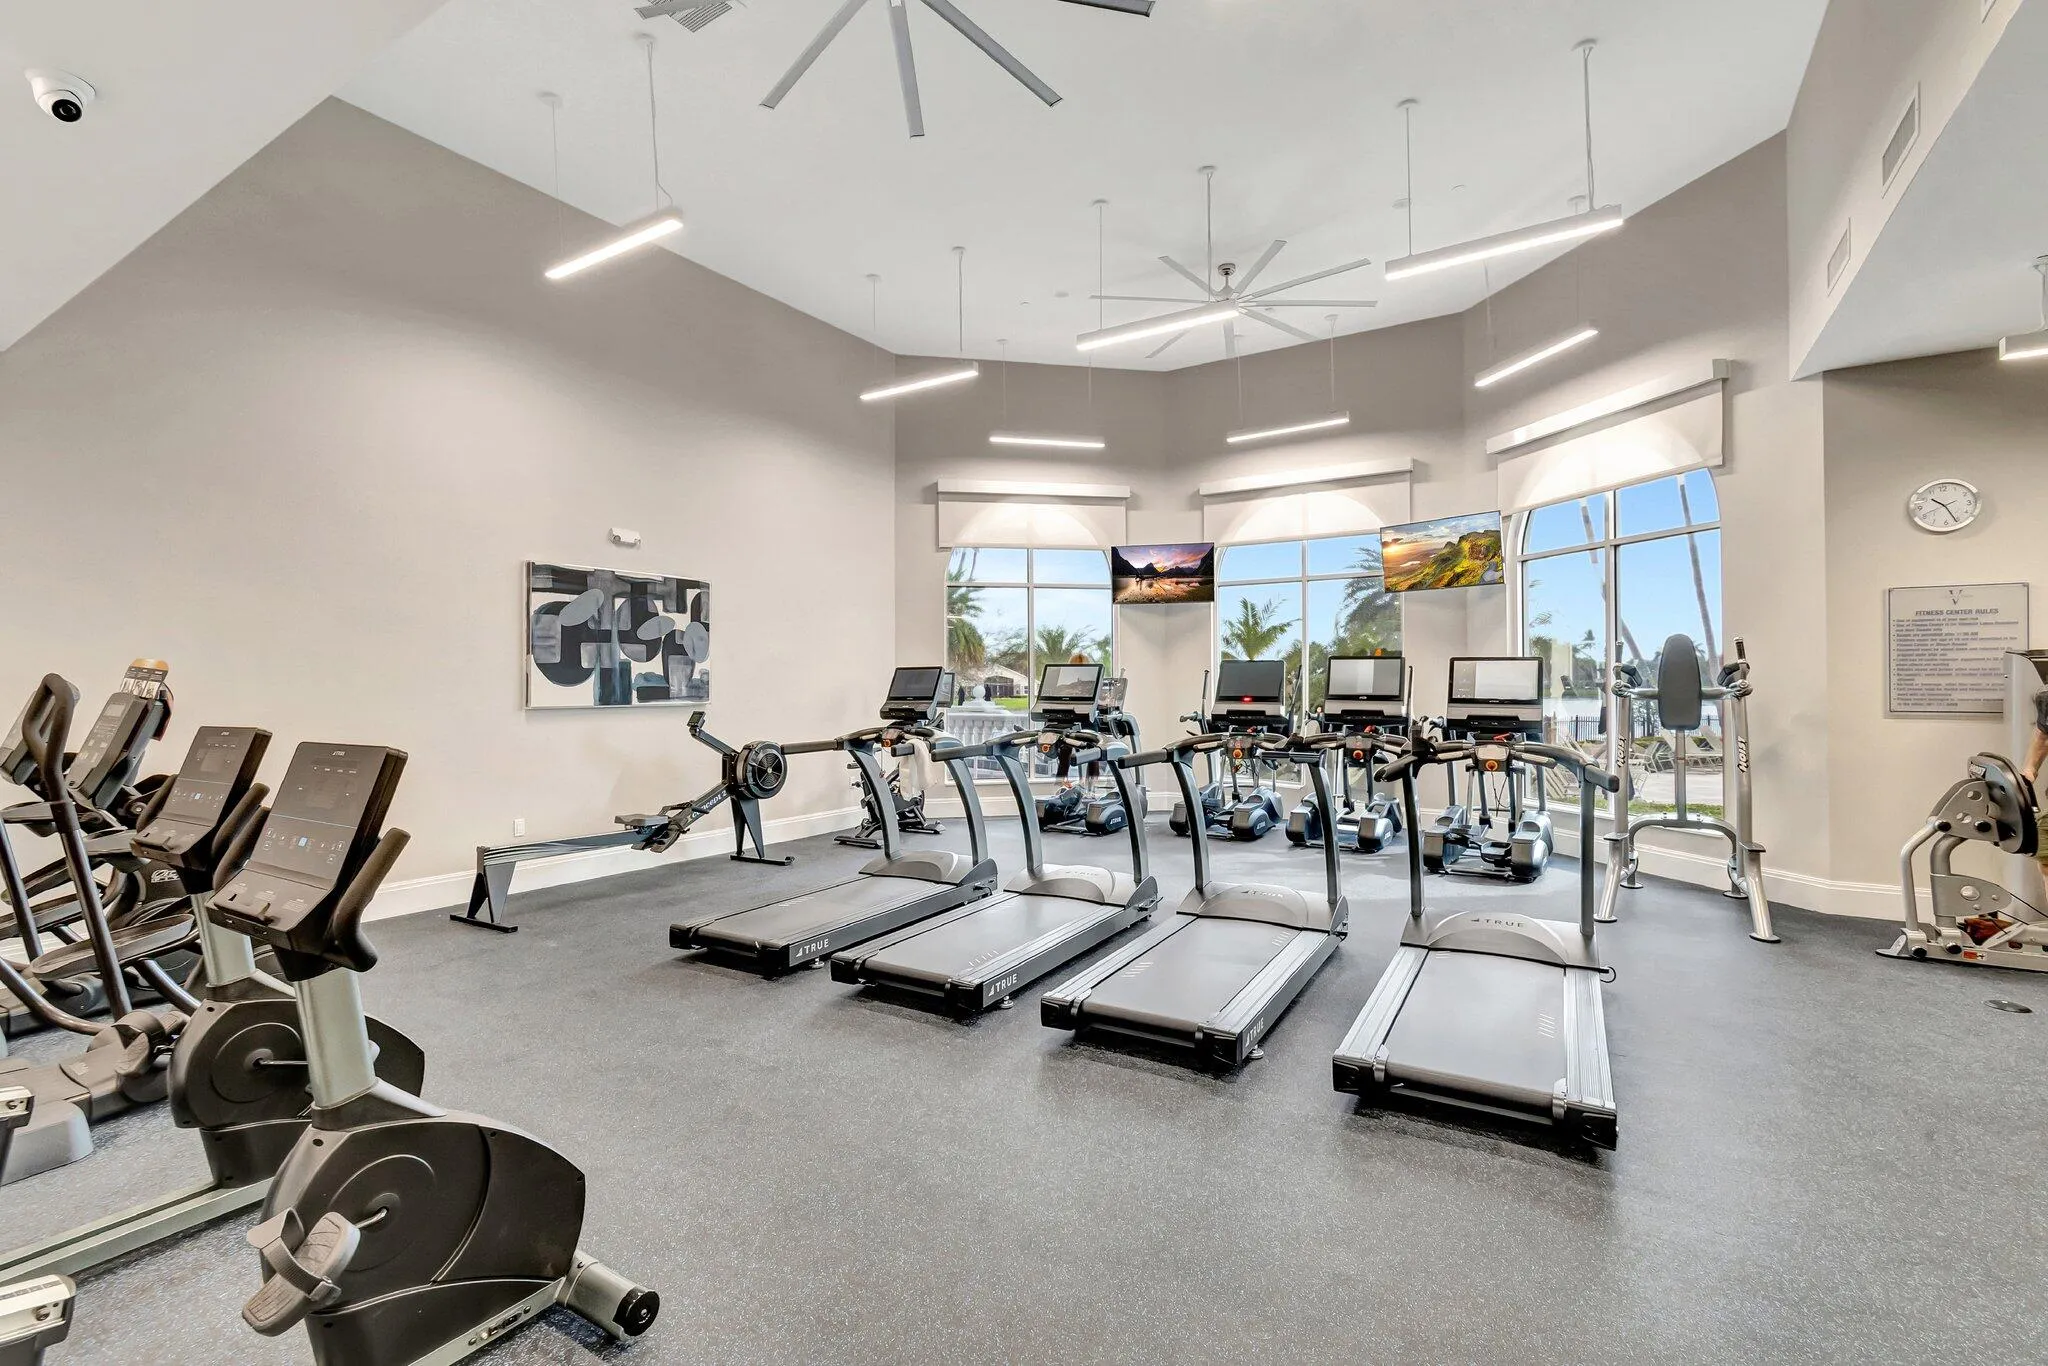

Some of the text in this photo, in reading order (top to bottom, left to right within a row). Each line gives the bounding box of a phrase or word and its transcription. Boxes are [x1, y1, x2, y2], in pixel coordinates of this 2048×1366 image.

[1484, 918, 1525, 928] TRUE
[804, 938, 829, 954] TRUE
[995, 973, 1018, 992] TRUE
[1249, 1017, 1264, 1041] TRUE
